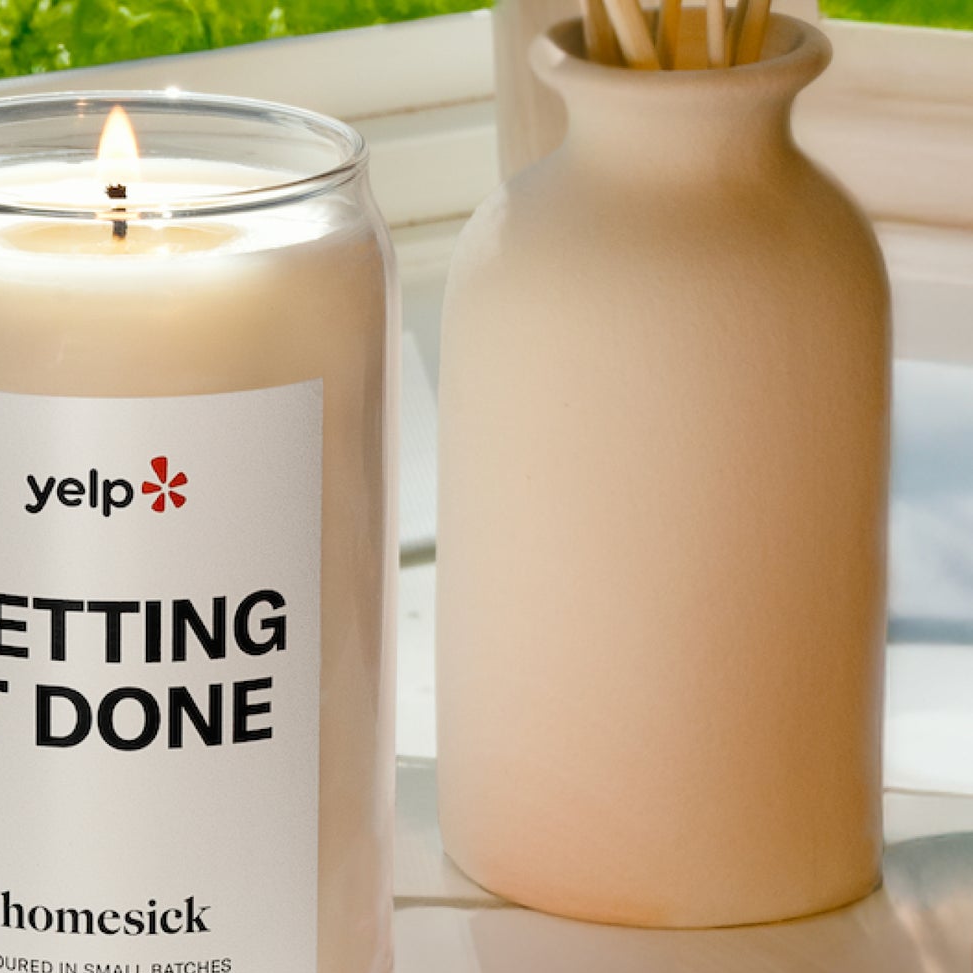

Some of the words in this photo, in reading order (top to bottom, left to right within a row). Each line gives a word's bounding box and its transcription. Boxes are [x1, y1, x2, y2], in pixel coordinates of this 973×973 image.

[25, 468, 134, 517] yelp
[35, 676, 273, 752] DONE
[0, 890, 211, 936] homesick
